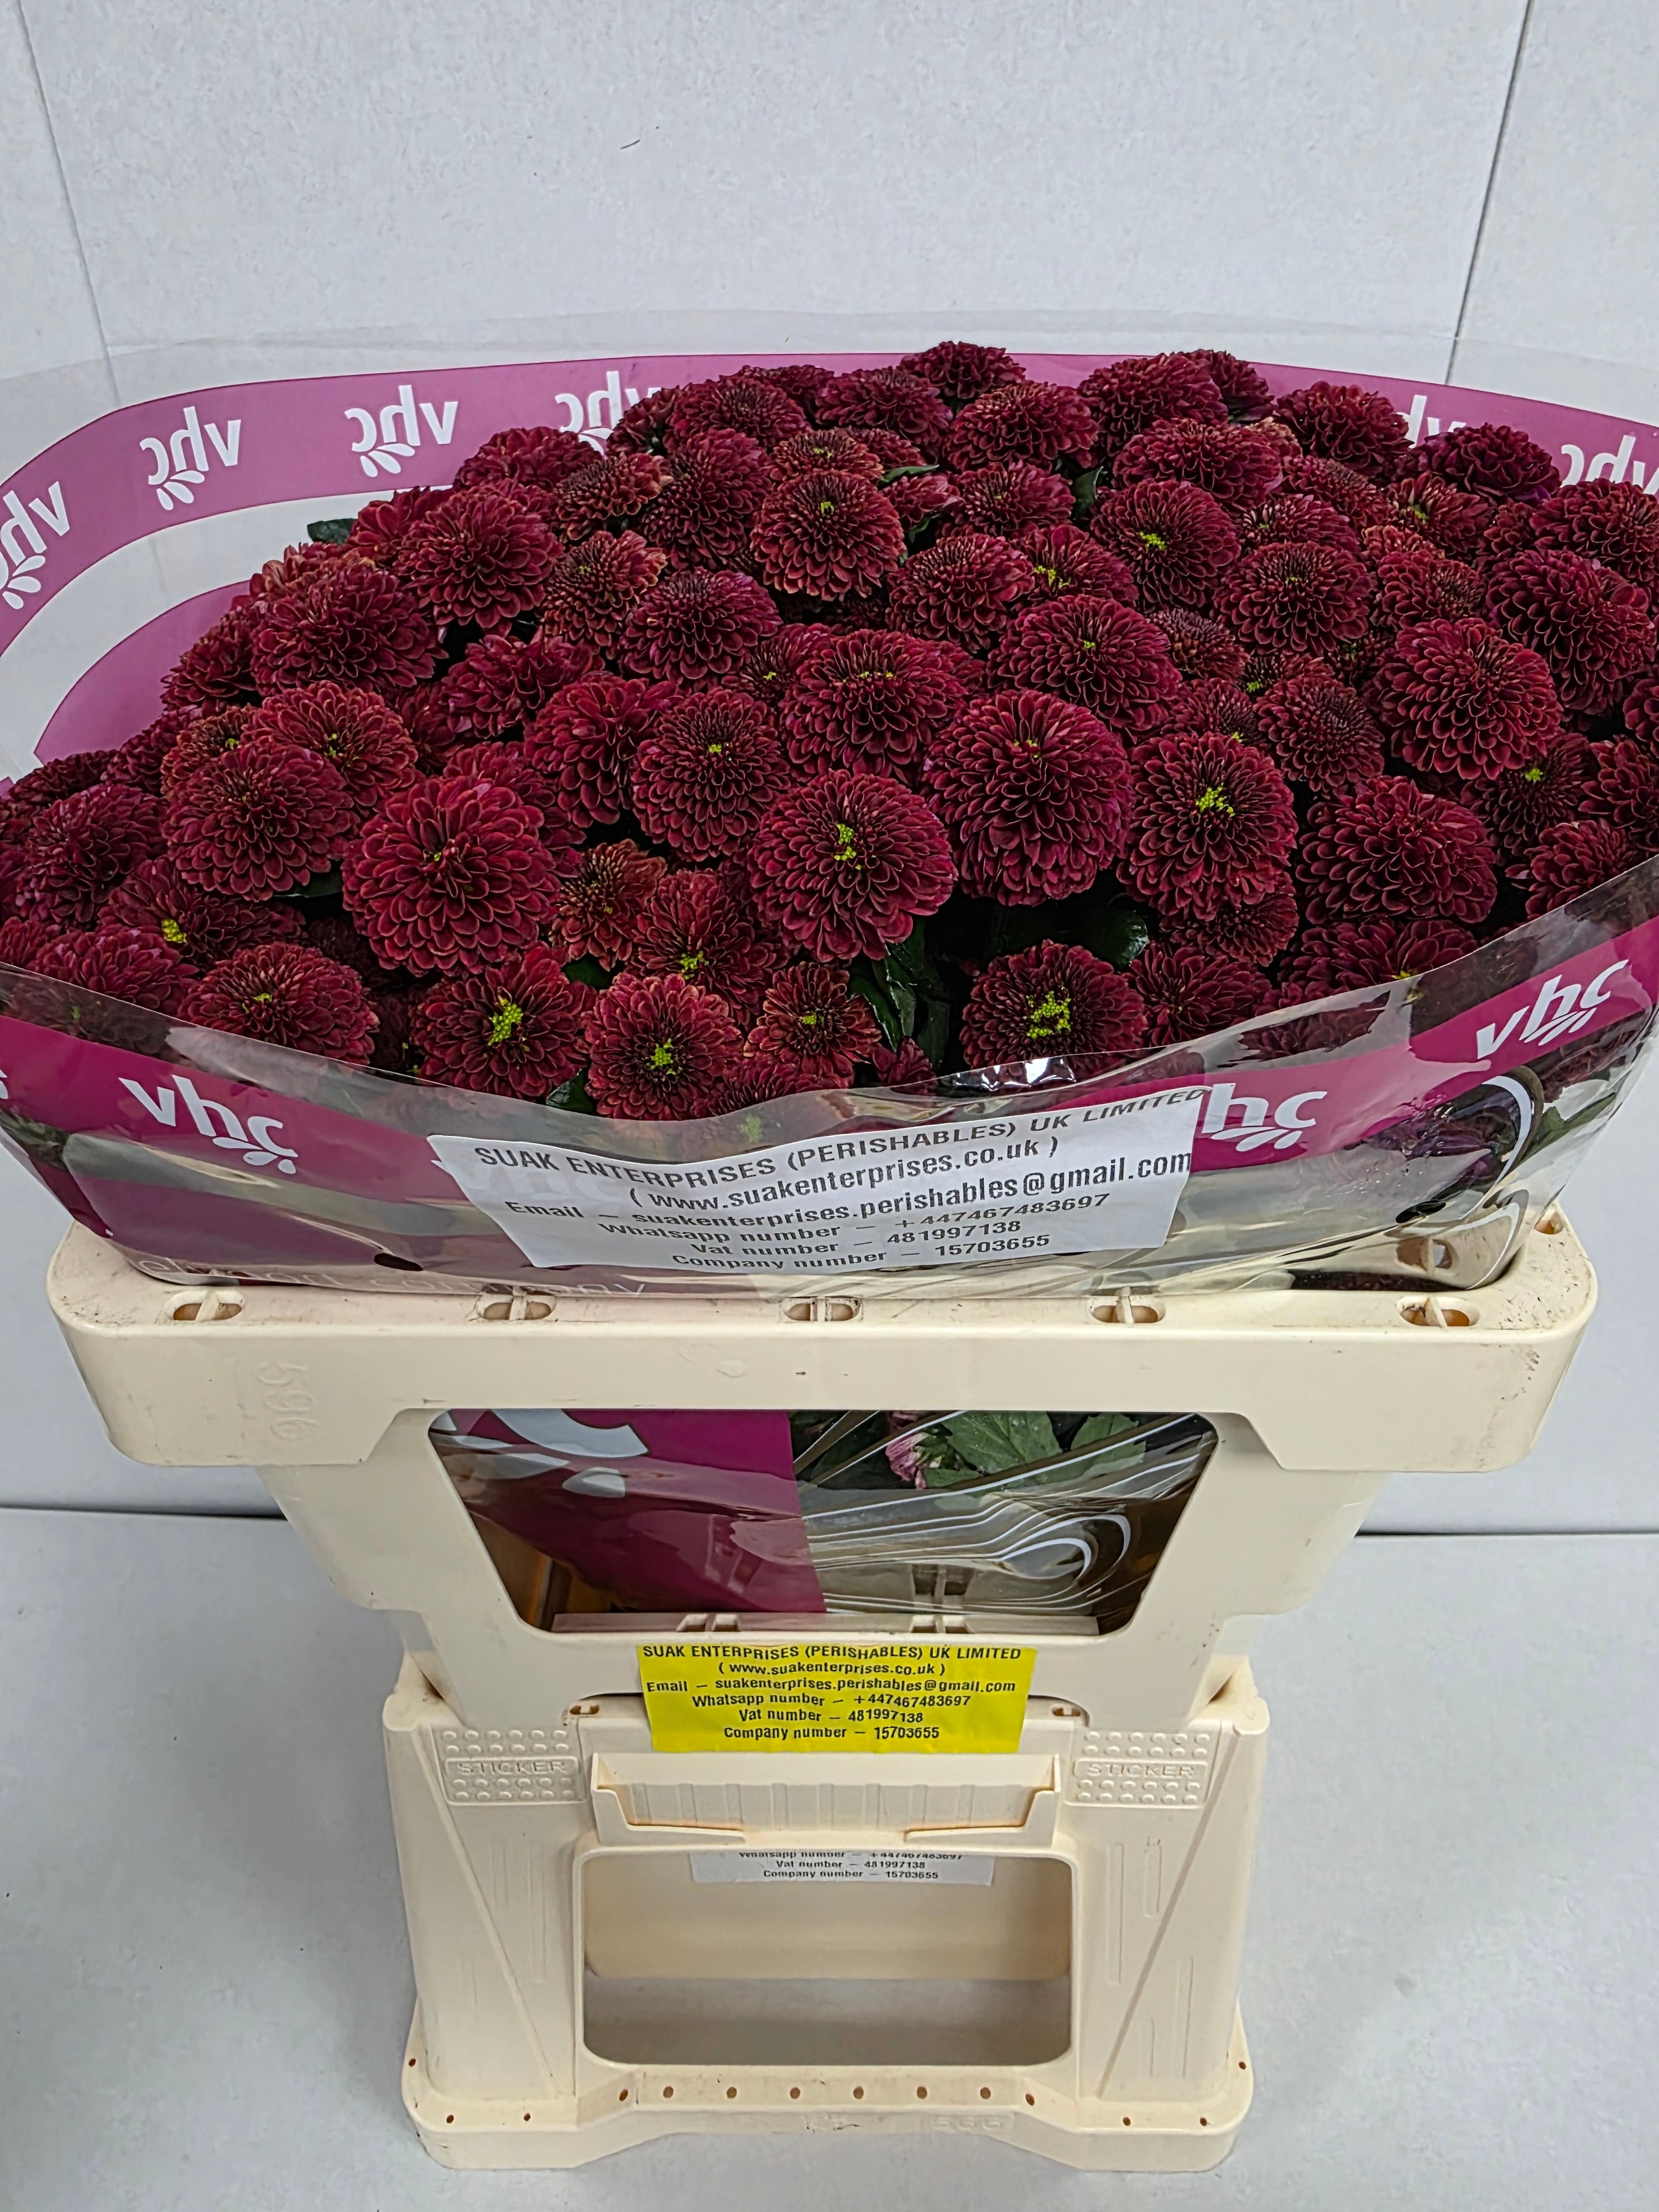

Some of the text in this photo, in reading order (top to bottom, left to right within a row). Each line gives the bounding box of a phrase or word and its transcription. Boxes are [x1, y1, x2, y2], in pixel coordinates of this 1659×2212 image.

[1477, 959, 1629, 1060] vhc
[1202, 1083, 1327, 1134] hc
[118, 1075, 299, 1158] vhc
[474, 1147, 560, 1171] SUAK
[566, 1156, 776, 1188] ENTERPRISES
[788, 1121, 1016, 1171] (PERISHABLES)
[1031, 1114, 1070, 1131] UK
[1083, 1089, 1205, 1122] LIMITED
[650, 1139, 1039, 1210] www.suakenterprises.co.uk
[505, 1201, 583, 1218] Email
[632, 1152, 1192, 1230] suakenterprises.perishables@gmail.com
[598, 1223, 730, 1243] Whatsapp
[741, 1225, 841, 1243] number
[893, 1193, 1110, 1229] +447467483697
[691, 1243, 732, 1255] Vat
[742, 1241, 839, 1256] number
[887, 1221, 1021, 1244] 481997138
[672, 1255, 783, 1269] Company
[794, 1251, 886, 1267] number
[936, 1234, 1050, 1256] 15703655
[643, 1645, 1021, 1660] SUAK ENTERPRISES (PERISHABLES) UK LIMITED
[729, 1662, 935, 1675] www.suakenterprises.co.uk
[647, 1679, 688, 1692] Email
[715, 1677, 1015, 1692] suakenterprises.perishables@gmail.com
[692, 1694, 764, 1708] Whatsapp
[770, 1694, 825, 1706] number
[853, 1694, 971, 1707] +447467483697
[739, 1709, 763, 1722] Vat
[767, 1710, 821, 1722] number
[848, 1710, 924, 1723] 481997138
[724, 1726, 788, 1741] Company
[794, 1726, 847, 1739] number
[874, 1726, 940, 1740] 15703655
[457, 1761, 567, 1775] STICKER
[1087, 1764, 1193, 1778] STICKER
[776, 1860, 795, 1869] Vat
[799, 1860, 842, 1869] number
[864, 1860, 925, 1869] 481997138
[764, 1870, 816, 1880] Company
[820, 1869, 863, 1879] number
[885, 1870, 938, 1879] 15703655
